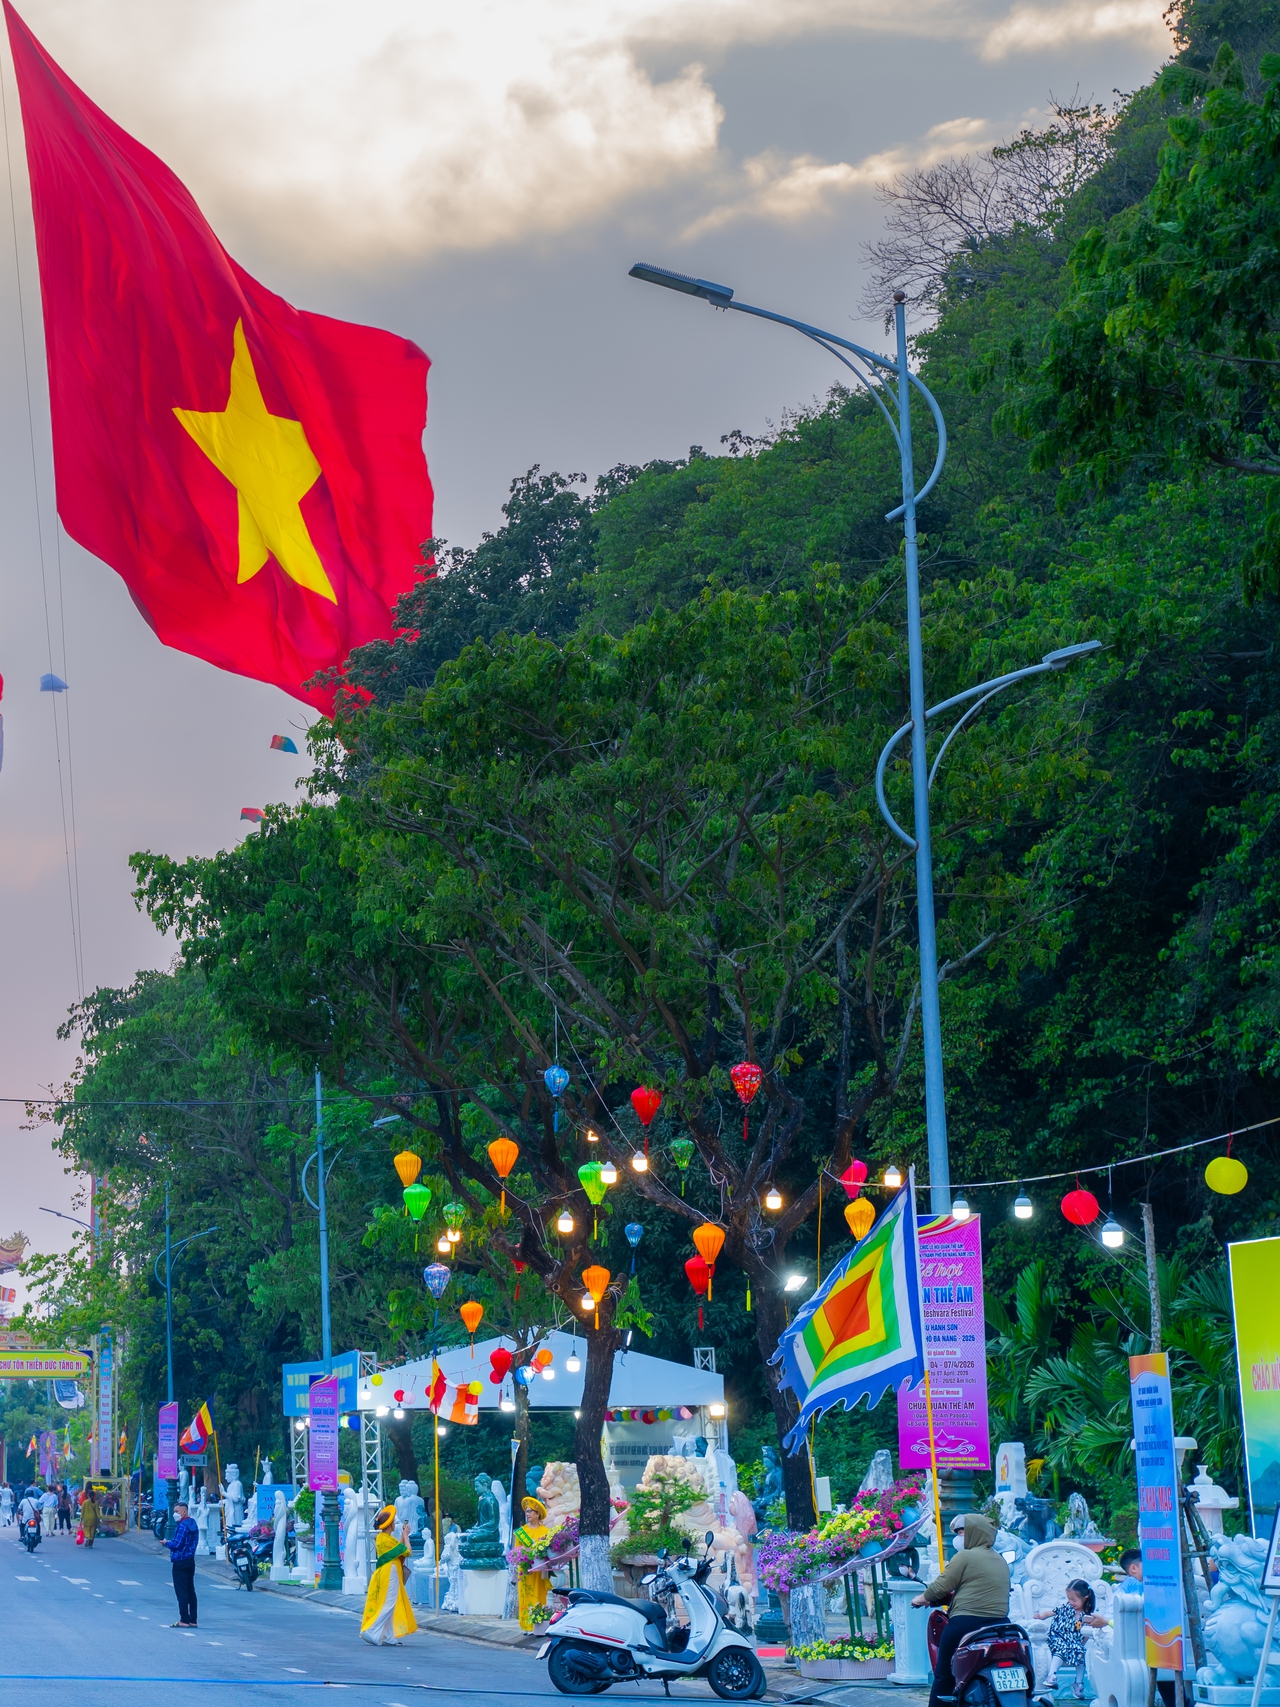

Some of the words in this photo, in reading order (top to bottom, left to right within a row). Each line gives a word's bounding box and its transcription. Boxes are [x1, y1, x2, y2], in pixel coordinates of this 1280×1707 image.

[936, 1262, 963, 1279] hội
[934, 1281, 954, 1303] THẾ
[956, 1283, 973, 1303] ÂM
[924, 1308, 949, 1317] teshvara
[951, 1308, 974, 1317] Festival
[13, 1358, 24, 1369] TÔN
[26, 1357, 42, 1370] THIỀN
[59, 1359, 73, 1370] TĂNG
[76, 1361, 82, 1370] NI
[1252, 1356, 1270, 1391] CHÀO
[950, 1399, 961, 1409] THẾ
[964, 1400, 974, 1409] ÂM
[1158, 1486, 1172, 1517] MẠC
[997, 1670, 1020, 1679] 43-H1
[997, 1679, 1026, 1689] 362.22
